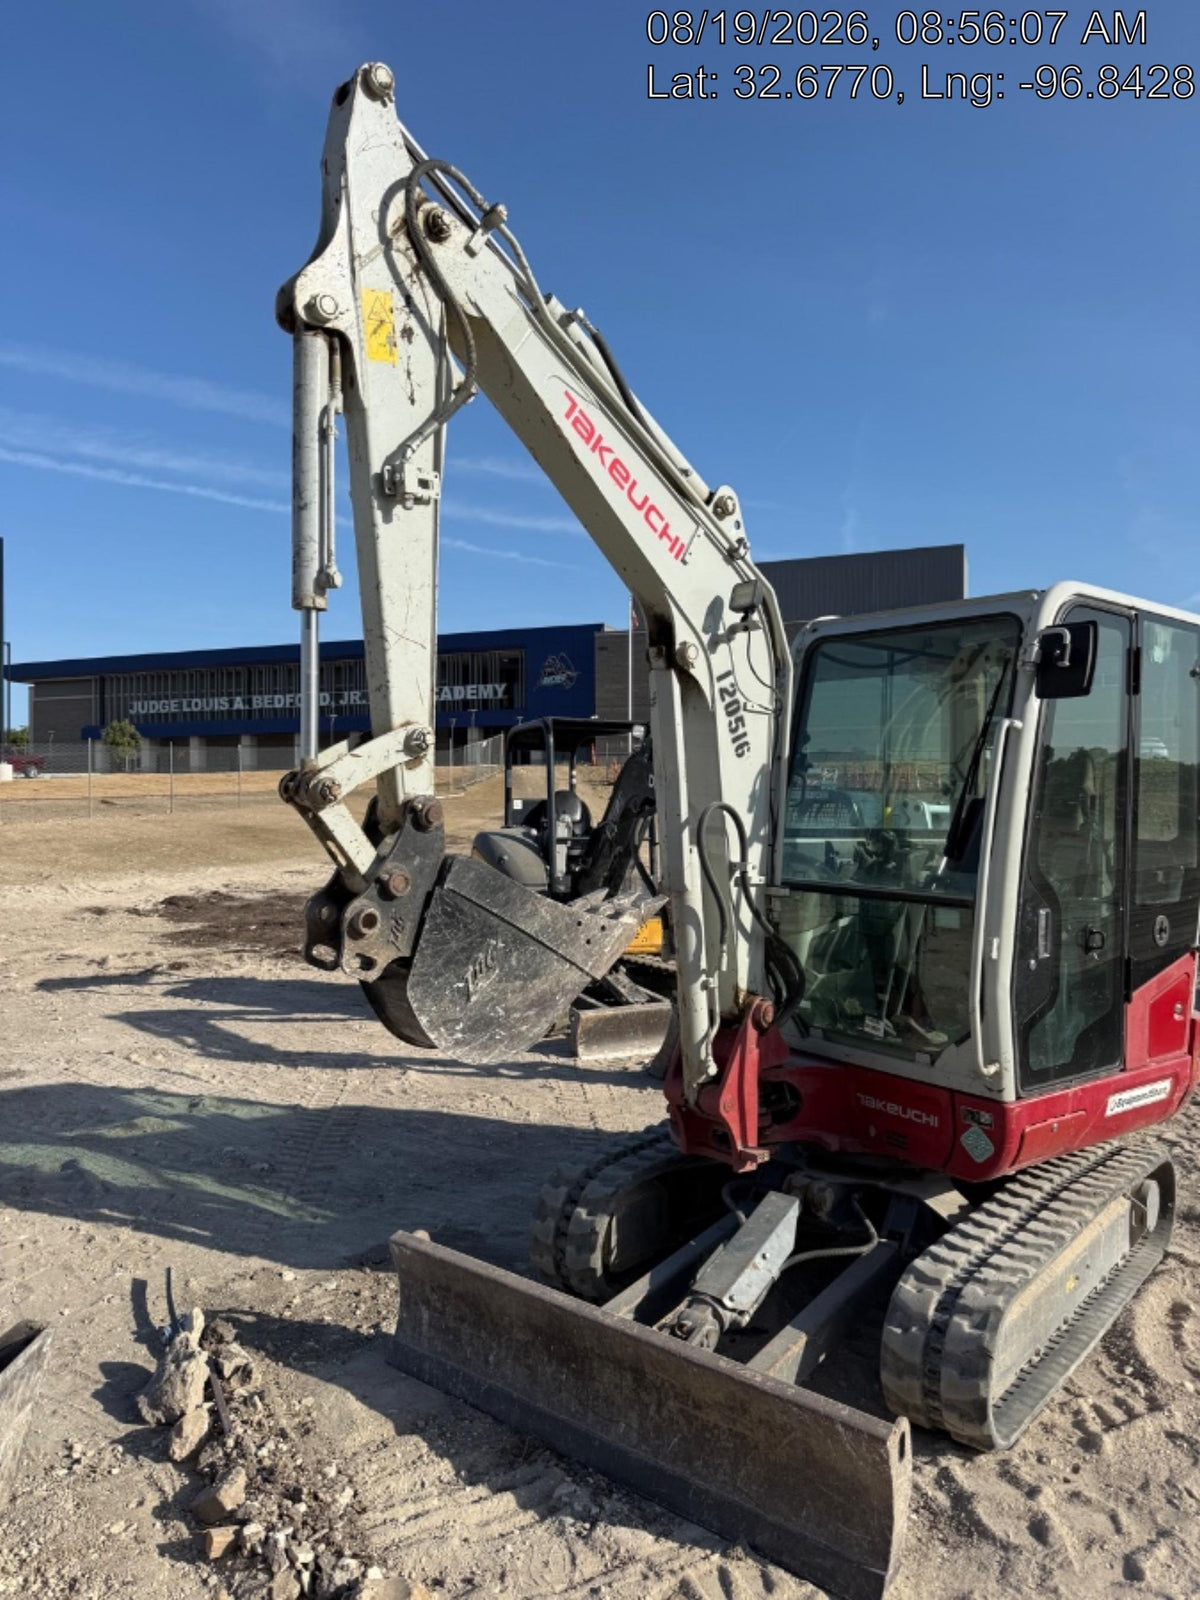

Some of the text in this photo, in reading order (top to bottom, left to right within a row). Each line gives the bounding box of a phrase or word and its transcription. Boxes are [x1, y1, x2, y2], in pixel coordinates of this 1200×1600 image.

[129, 701, 180, 714] JUDGE
[182, 697, 230, 712] LOUIS
[233, 697, 249, 710] A.
[716, 669, 751, 758] 120516
